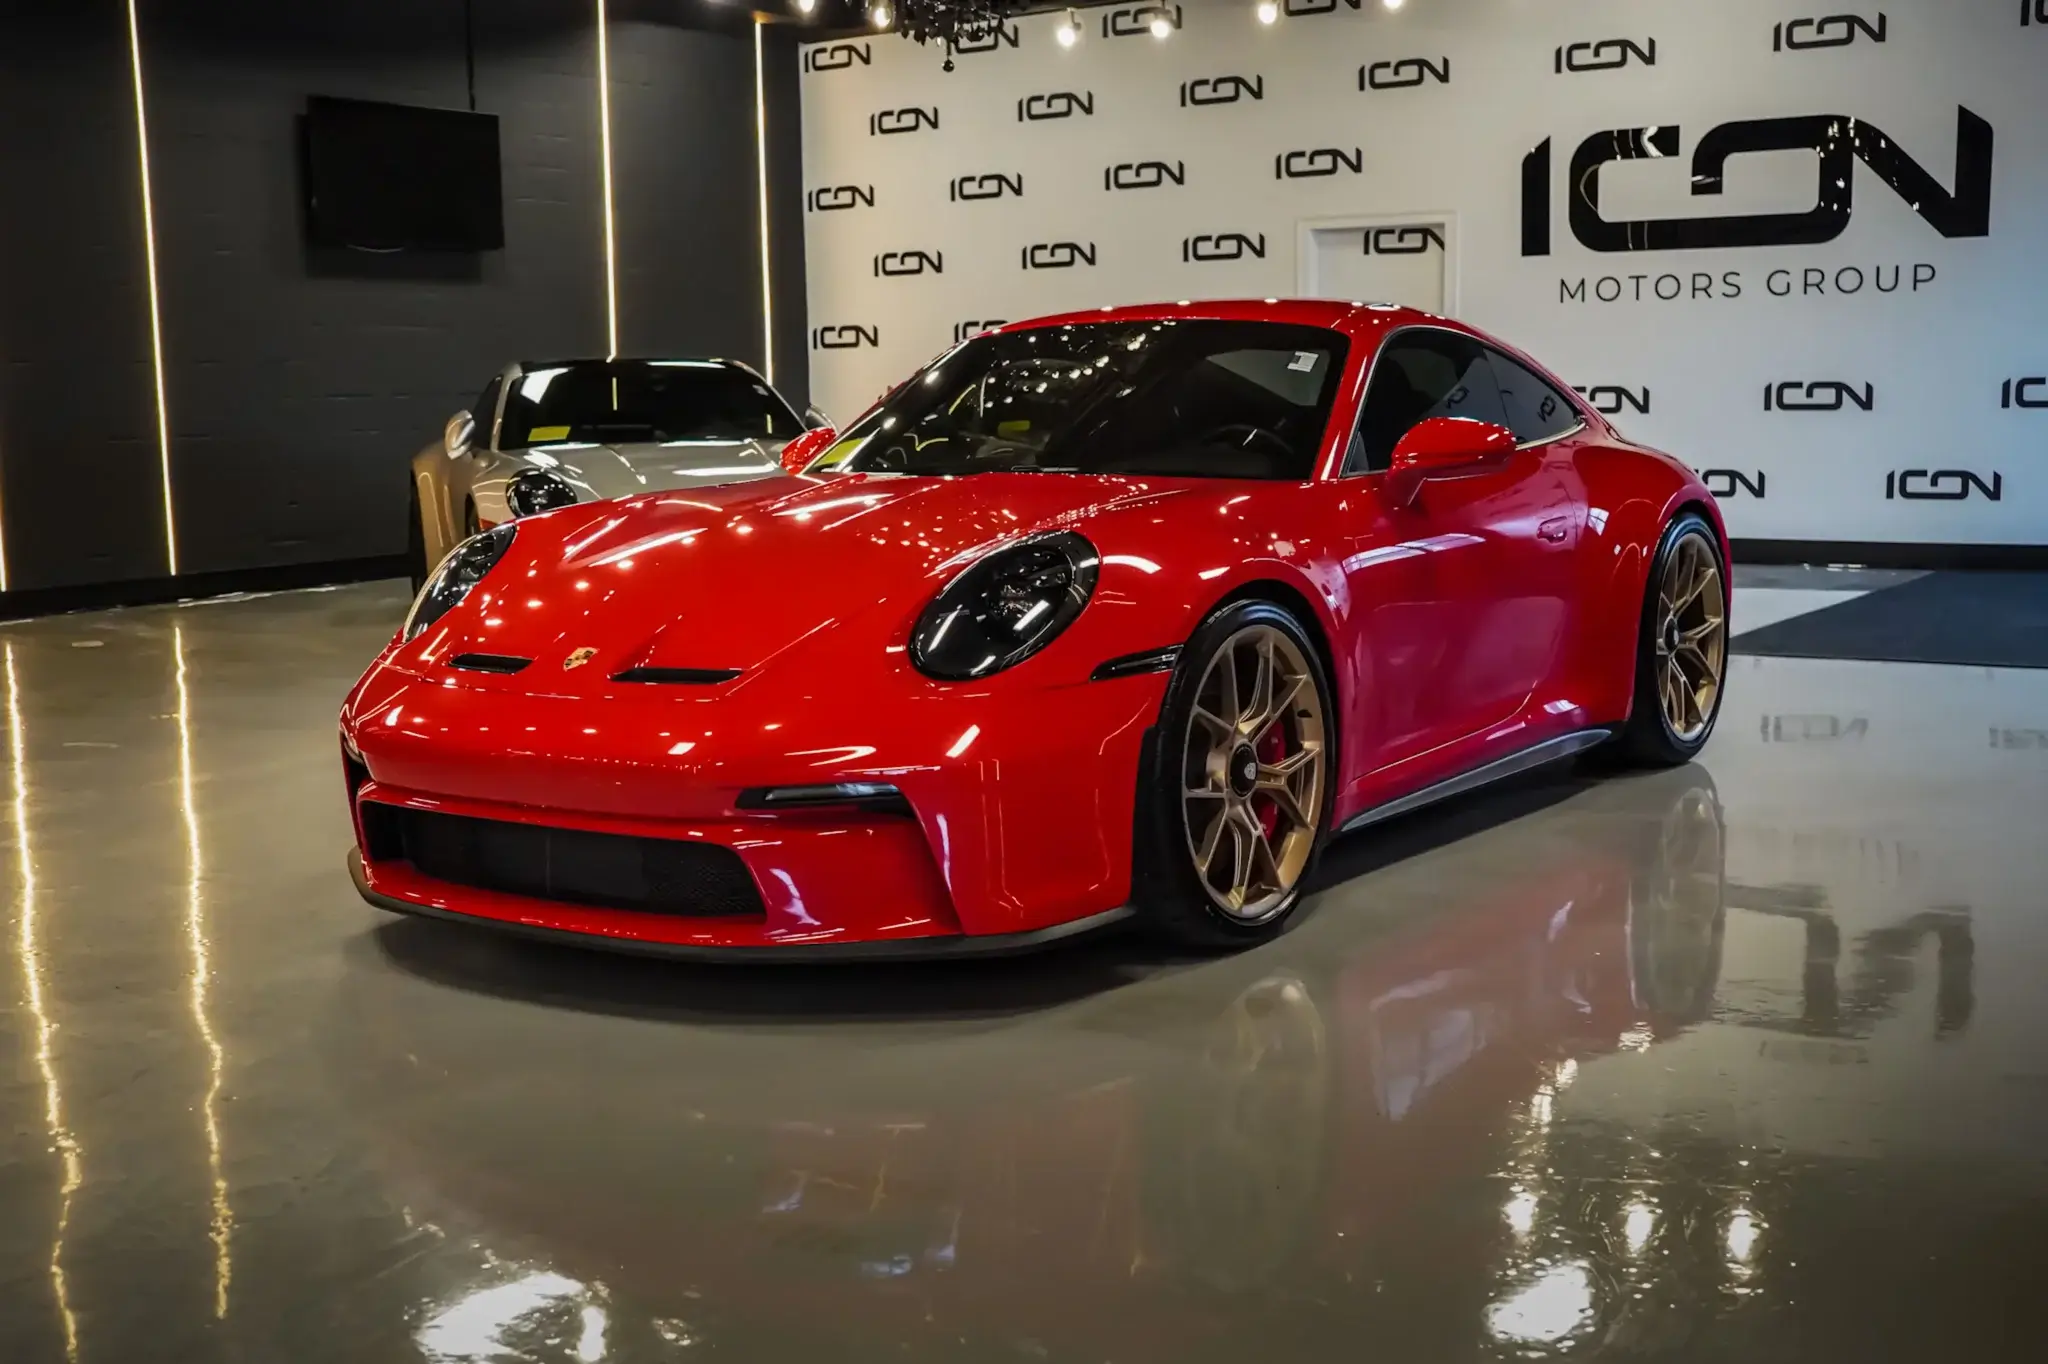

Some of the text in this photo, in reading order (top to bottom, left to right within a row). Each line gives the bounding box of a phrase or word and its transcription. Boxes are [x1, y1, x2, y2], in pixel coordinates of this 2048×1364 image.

[1773, 12, 1886, 52] ICON
[804, 43, 871, 73] ICON
[1555, 37, 1655, 74] ICON
[1358, 57, 1449, 91] ICON
[1018, 91, 1093, 122] ICON
[1181, 75, 1263, 107] ICON
[870, 107, 938, 136] ICON
[1105, 160, 1184, 191] ICON
[1276, 148, 1362, 180] ICON
[951, 173, 1022, 202] ICON
[1521, 104, 1994, 257] ICON
[808, 185, 874, 212] ICON
[1022, 242, 1096, 269] ICON
[1183, 233, 1265, 262] ICON
[874, 250, 942, 277] ICON
[1560, 264, 1936, 303] MOTORS GROUP
[813, 325, 878, 350] ICON
[1764, 381, 1873, 411] ICON
[1886, 470, 2002, 501] ICON
